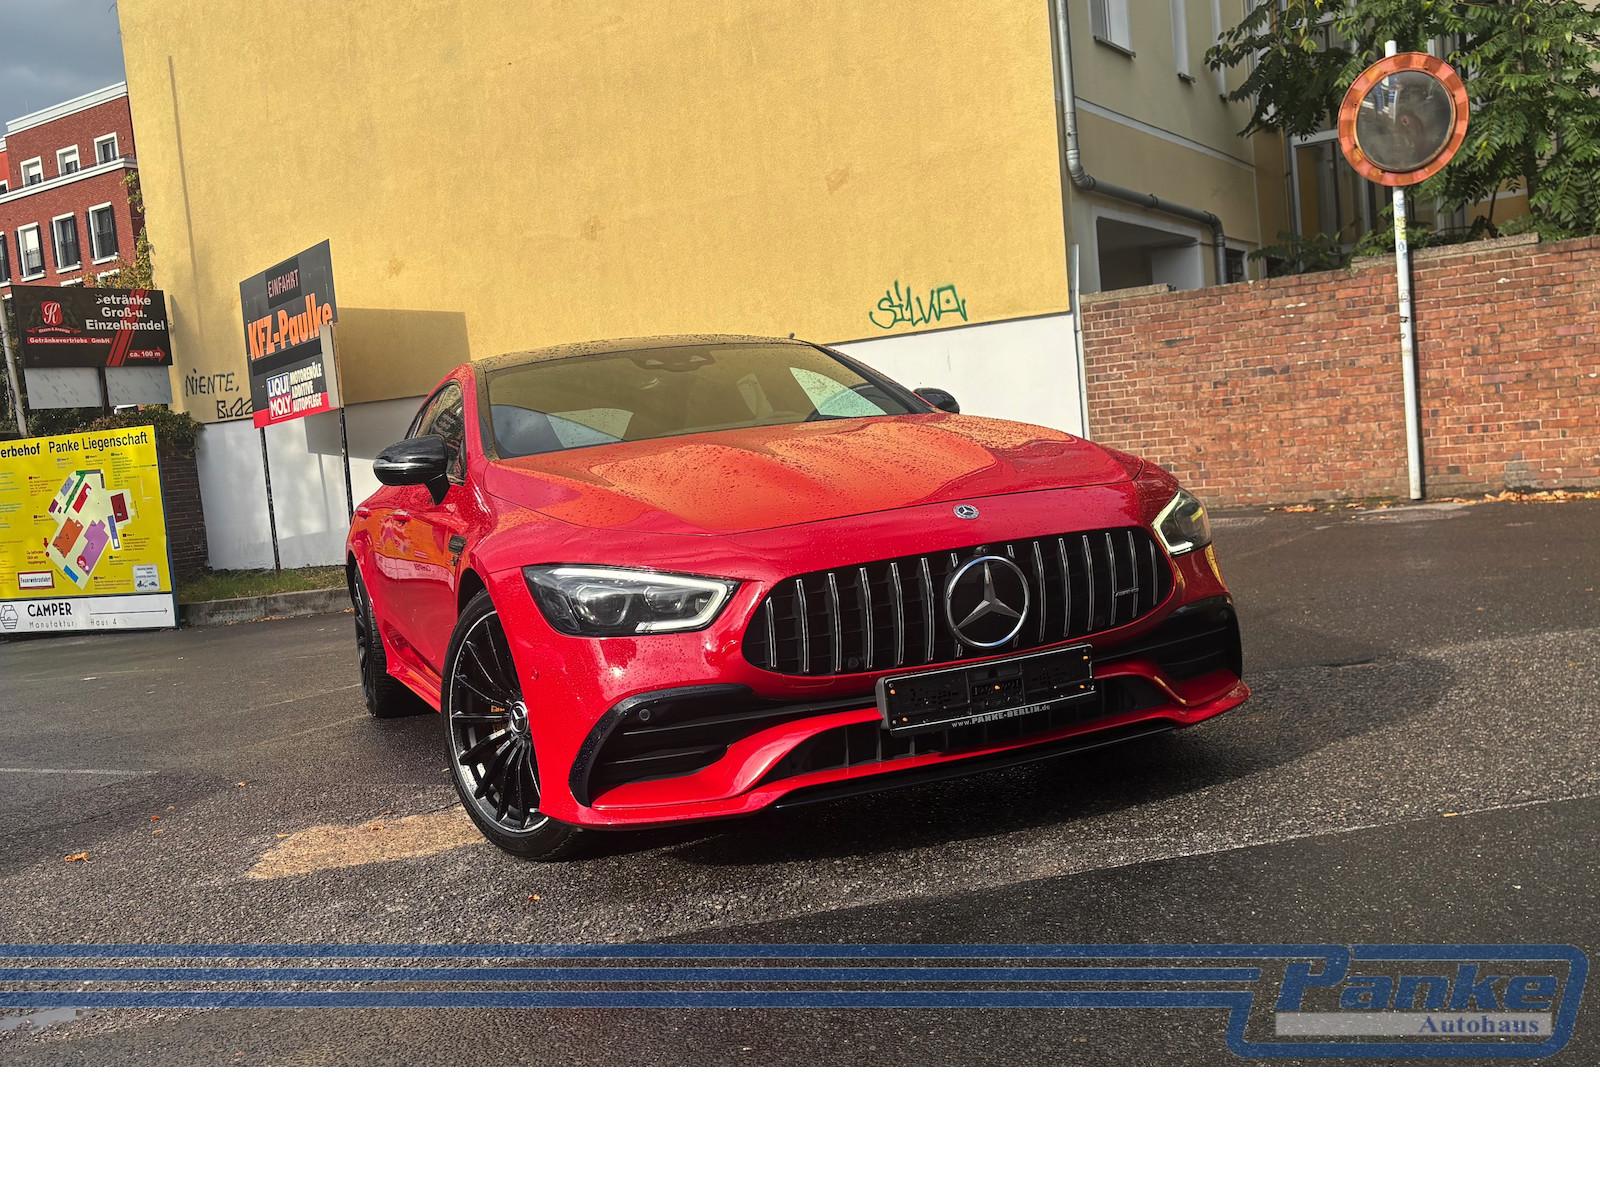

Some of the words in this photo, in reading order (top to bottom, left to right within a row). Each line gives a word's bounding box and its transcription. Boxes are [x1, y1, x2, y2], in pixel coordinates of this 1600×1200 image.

[268, 269, 298, 298] EINFAHRT
[101, 306, 148, 318] Groß-u.
[85, 319, 165, 331] Einzelhandel
[248, 293, 333, 361] KFZ-Paulke
[268, 375, 289, 397] LIQUI
[270, 395, 291, 417] MOLY
[48, 439, 80, 454] Panke
[81, 431, 148, 451] Liegenschaft
[27, 602, 73, 617] CAMPER
[29, 620, 74, 629] Manufaktur
